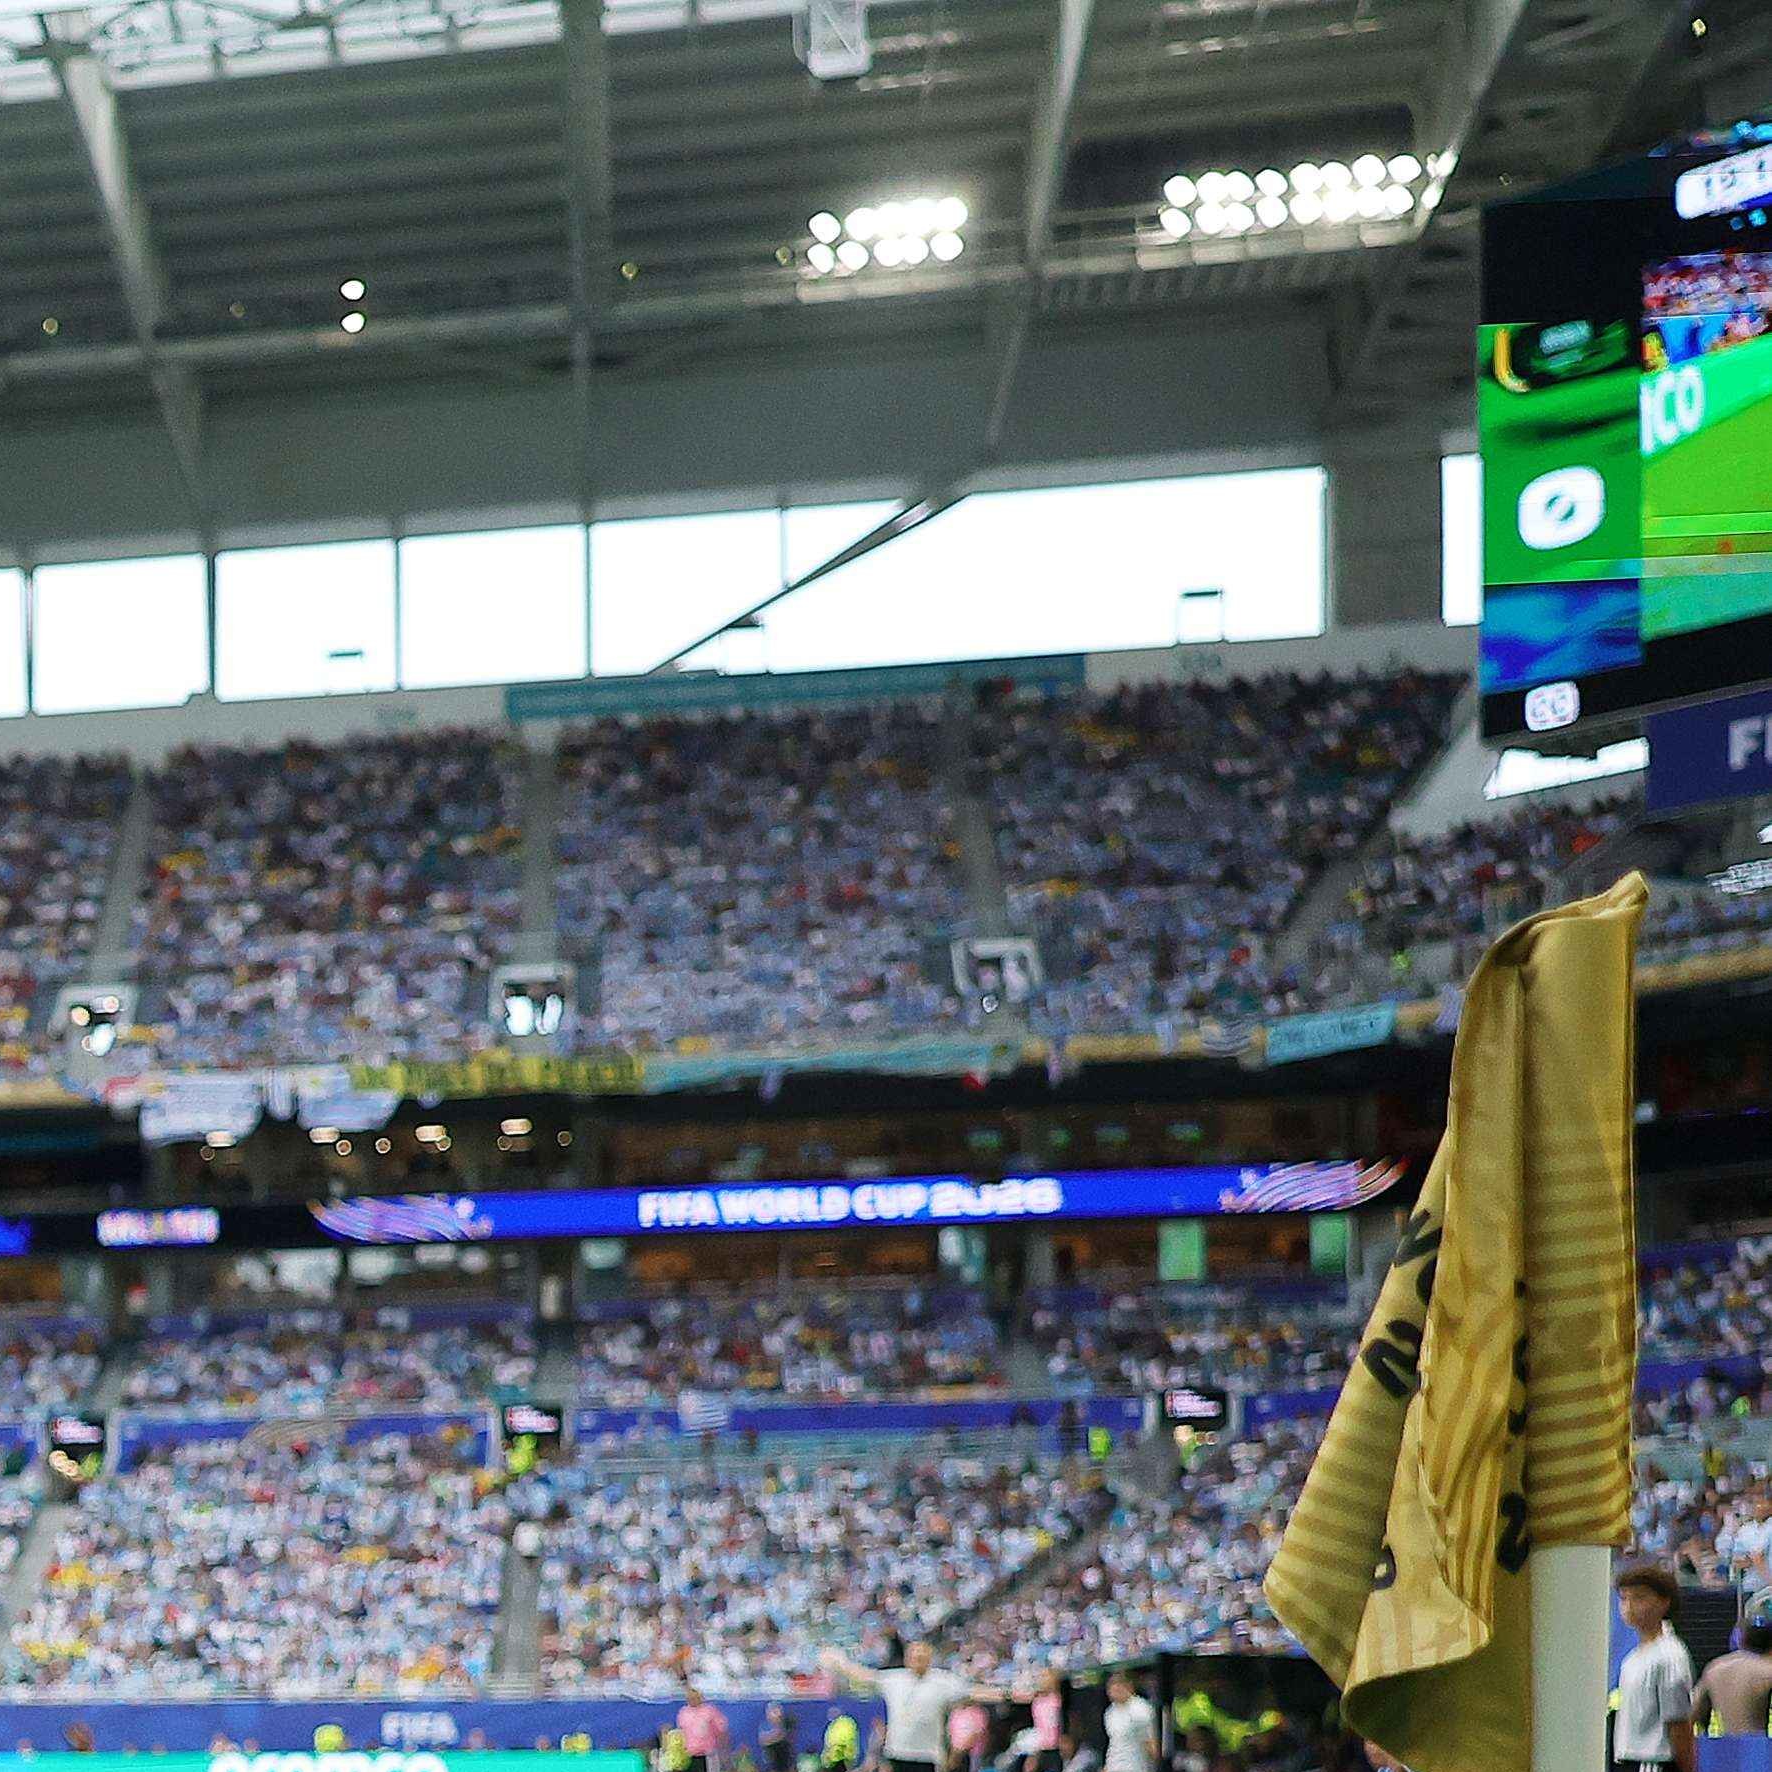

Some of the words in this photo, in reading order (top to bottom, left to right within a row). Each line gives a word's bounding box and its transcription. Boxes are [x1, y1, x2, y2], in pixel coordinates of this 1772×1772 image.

[637, 1190, 719, 1229] FIFA
[717, 1185, 851, 1225] WORLD
[851, 1182, 928, 1220] CUP
